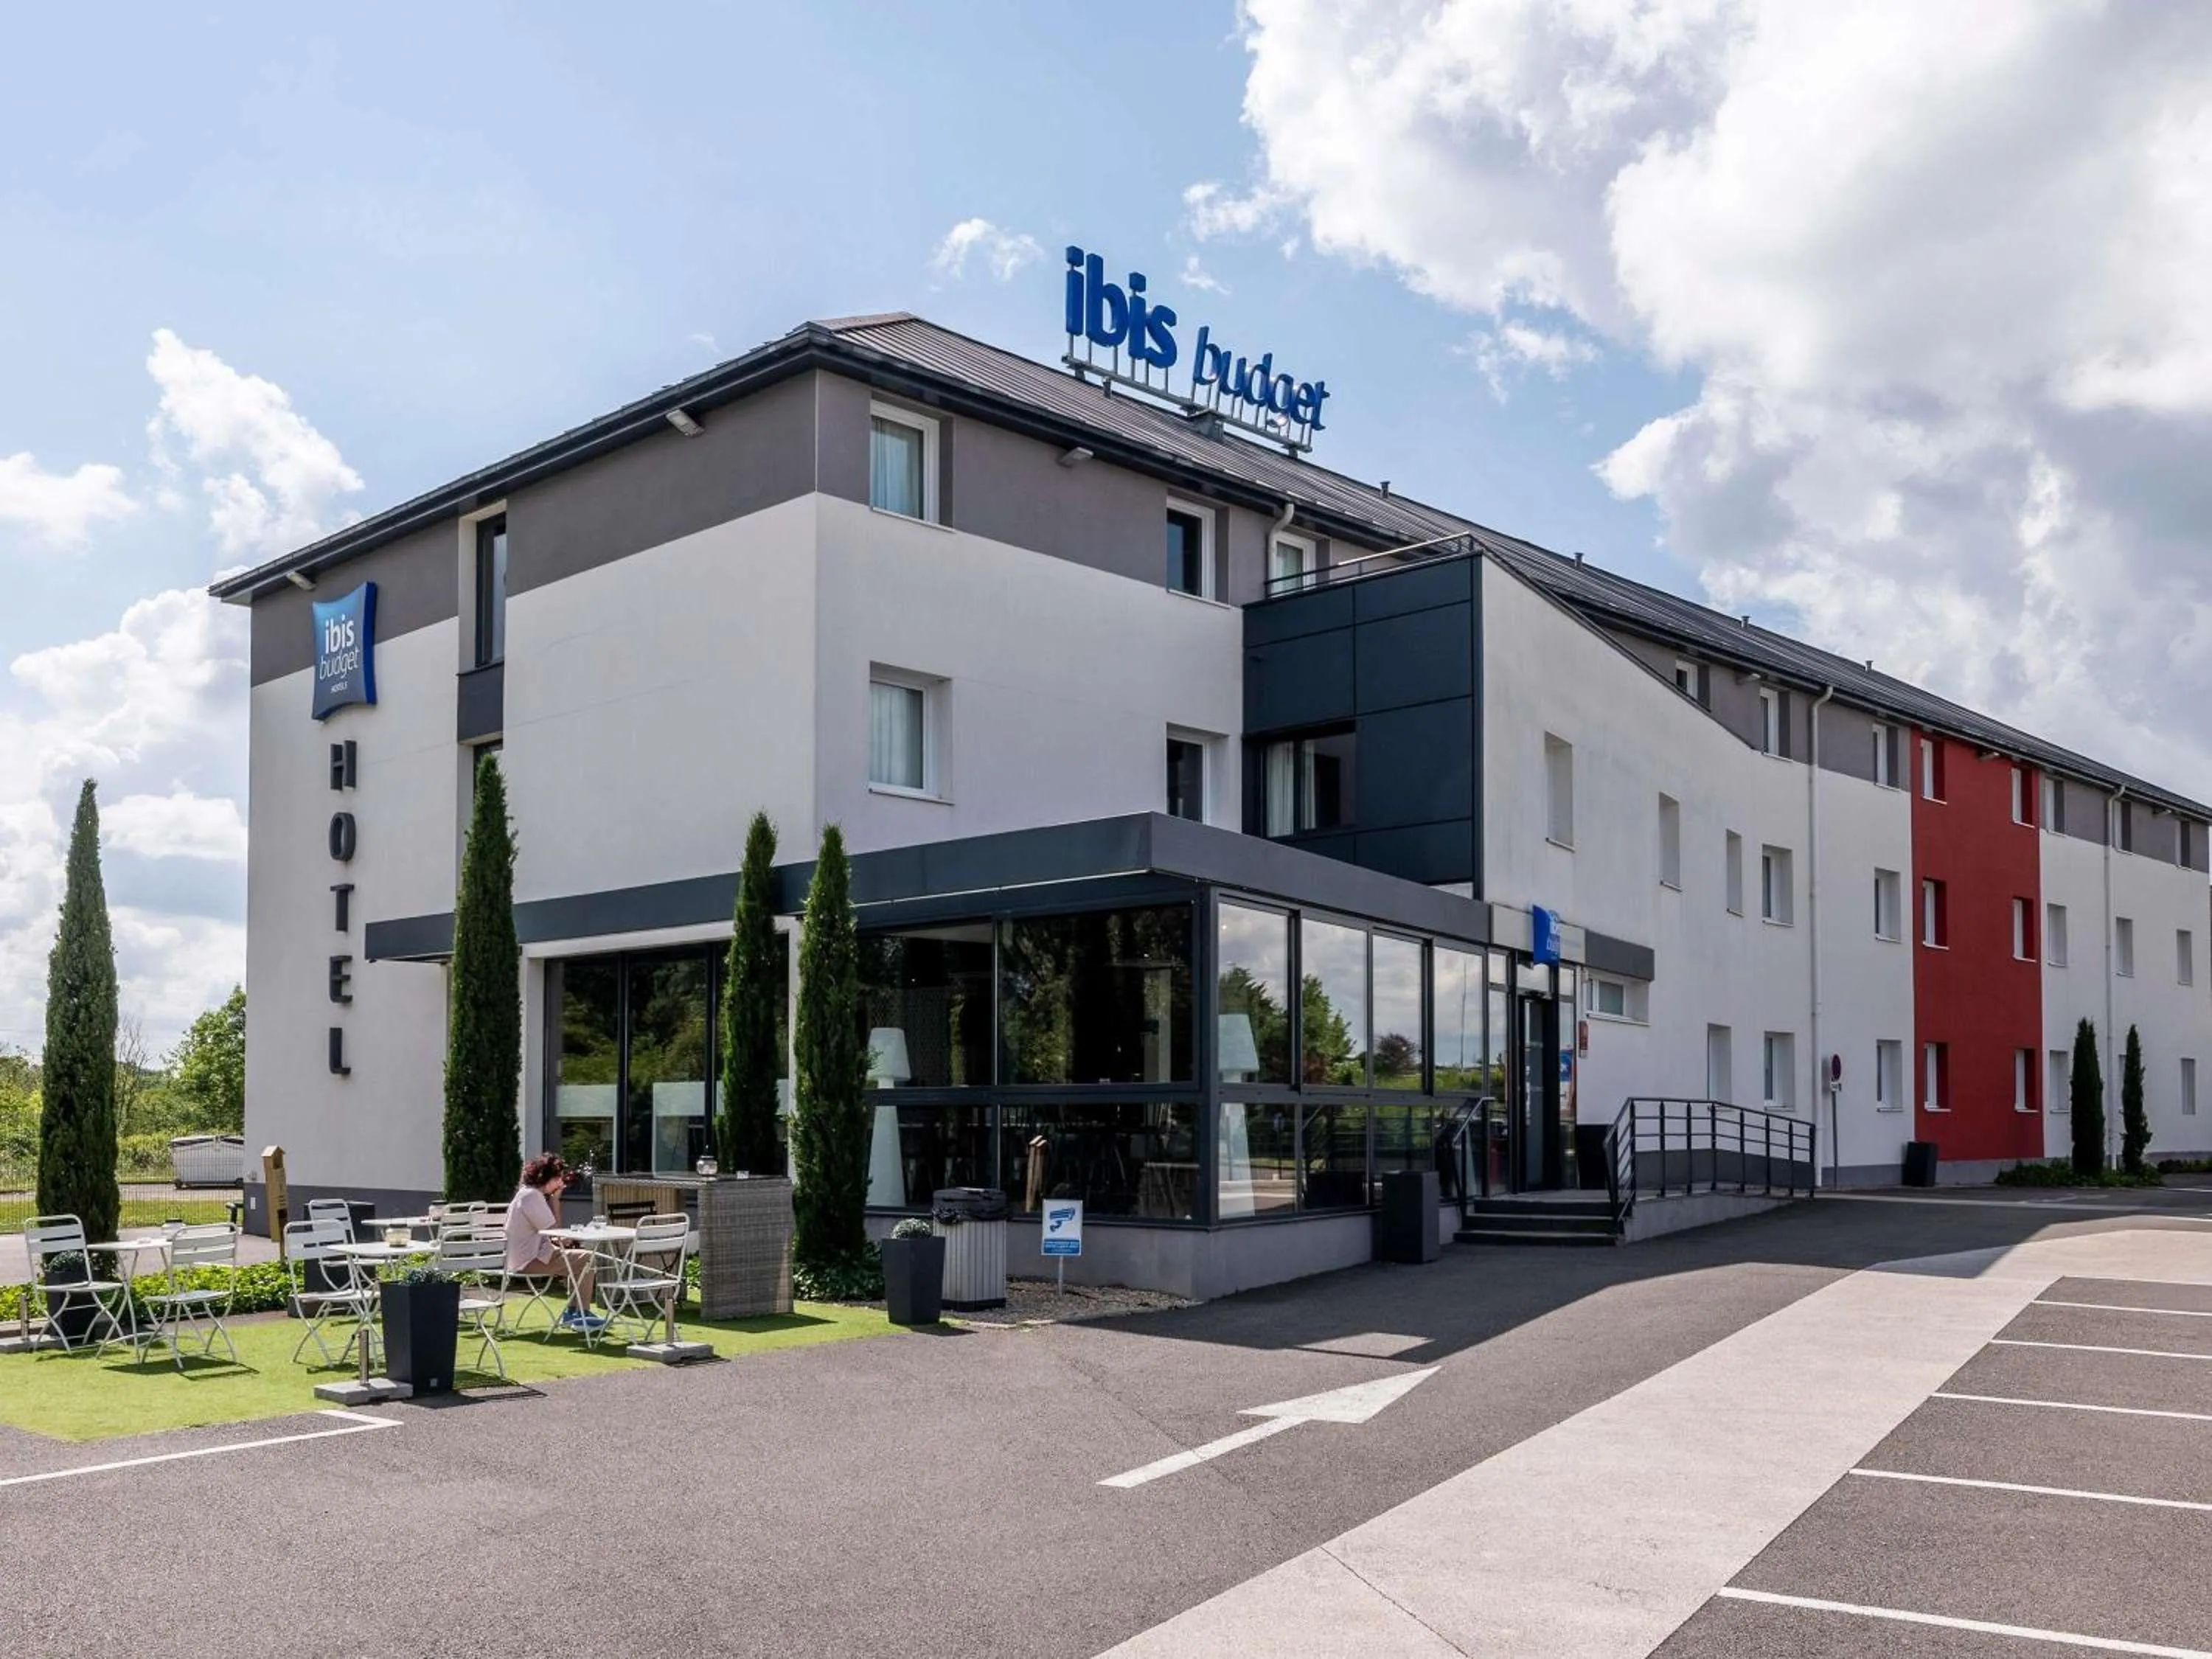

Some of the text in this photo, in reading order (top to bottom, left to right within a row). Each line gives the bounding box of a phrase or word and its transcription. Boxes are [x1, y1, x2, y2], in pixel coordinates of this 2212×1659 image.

[1065, 246, 1330, 431] ibis budget
[319, 646, 360, 680] budget
[325, 613, 355, 654] ibis
[329, 740, 358, 1075] HOTEL
